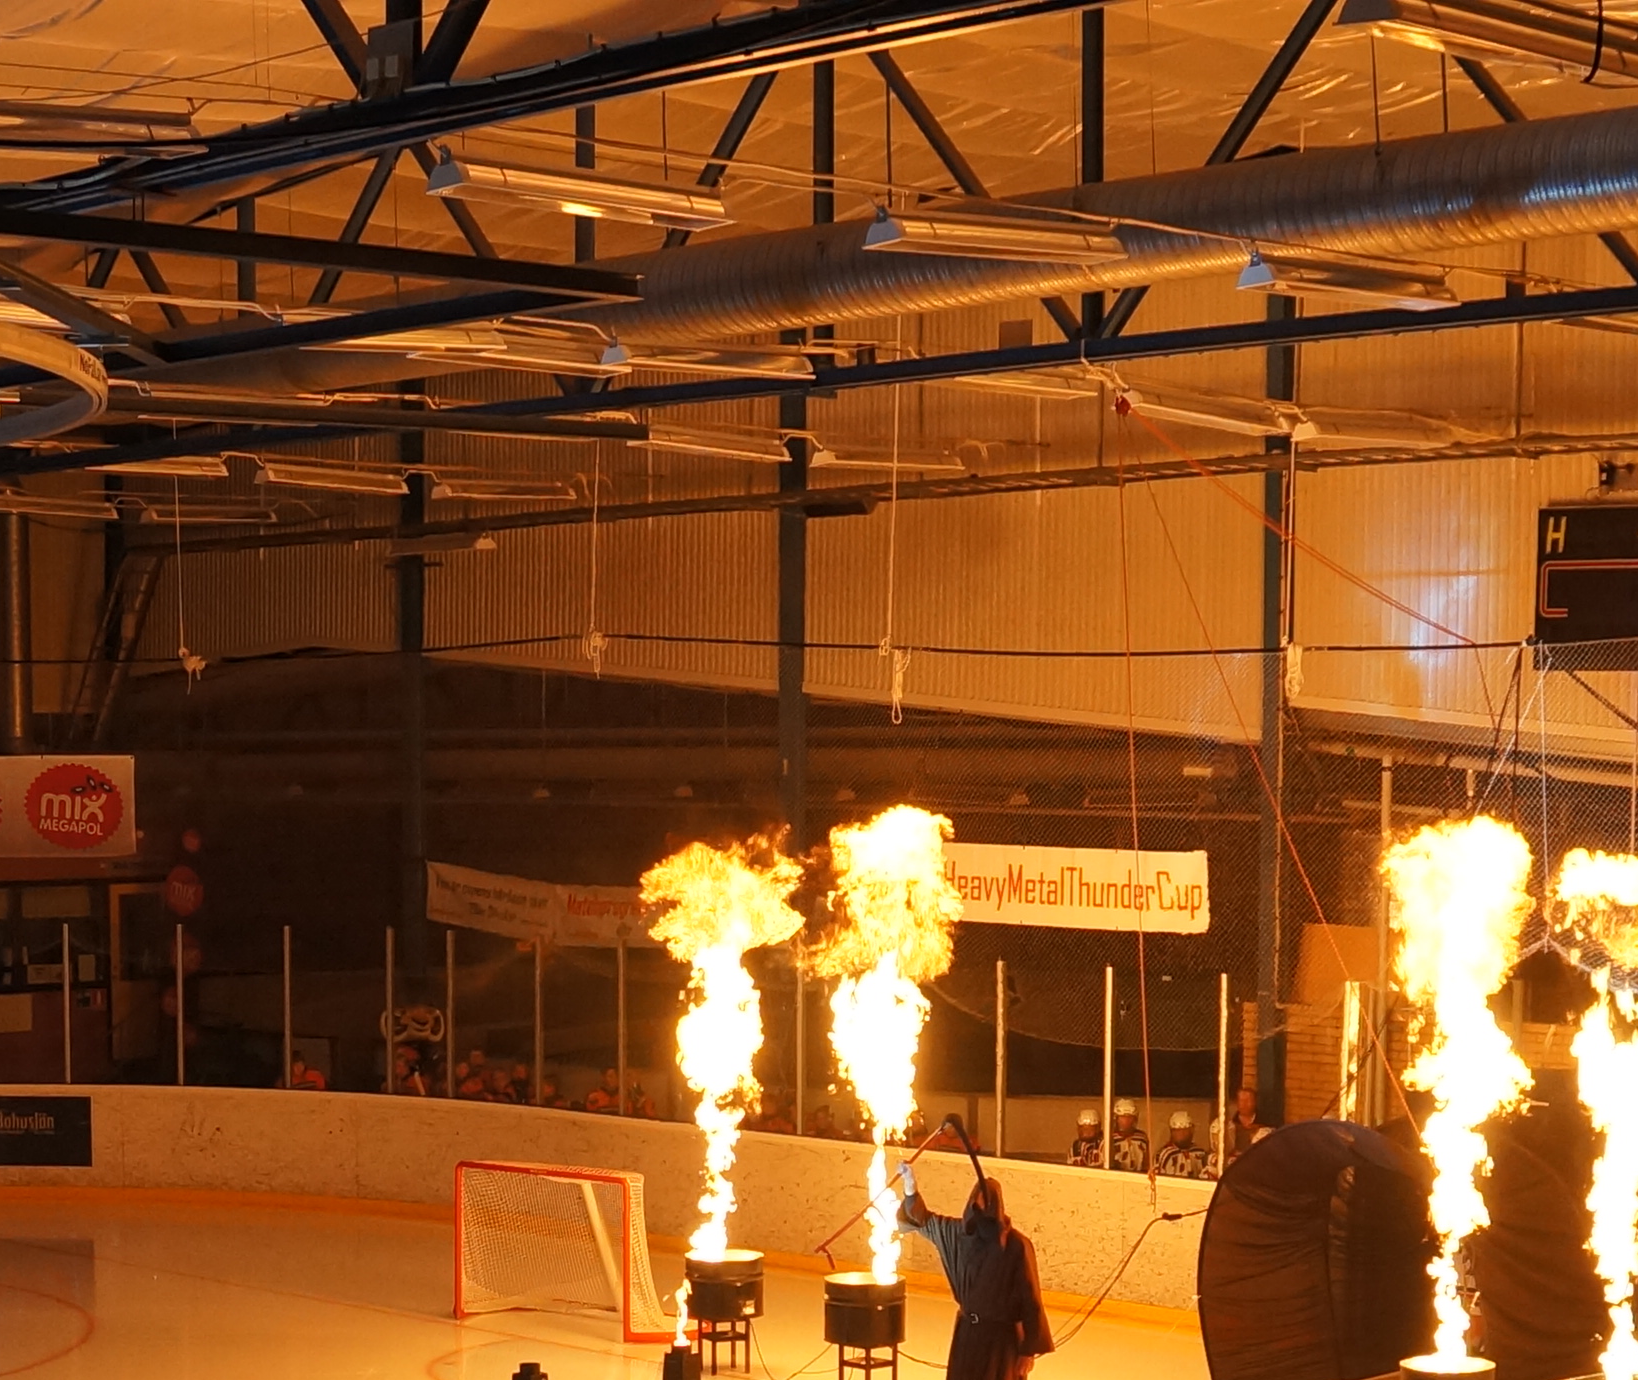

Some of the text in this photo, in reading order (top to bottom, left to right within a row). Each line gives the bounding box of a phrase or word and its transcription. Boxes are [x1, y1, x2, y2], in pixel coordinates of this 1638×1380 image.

[1545, 515, 1568, 555] H
[40, 793, 107, 823] mix
[39, 818, 103, 836] MEGAPOL
